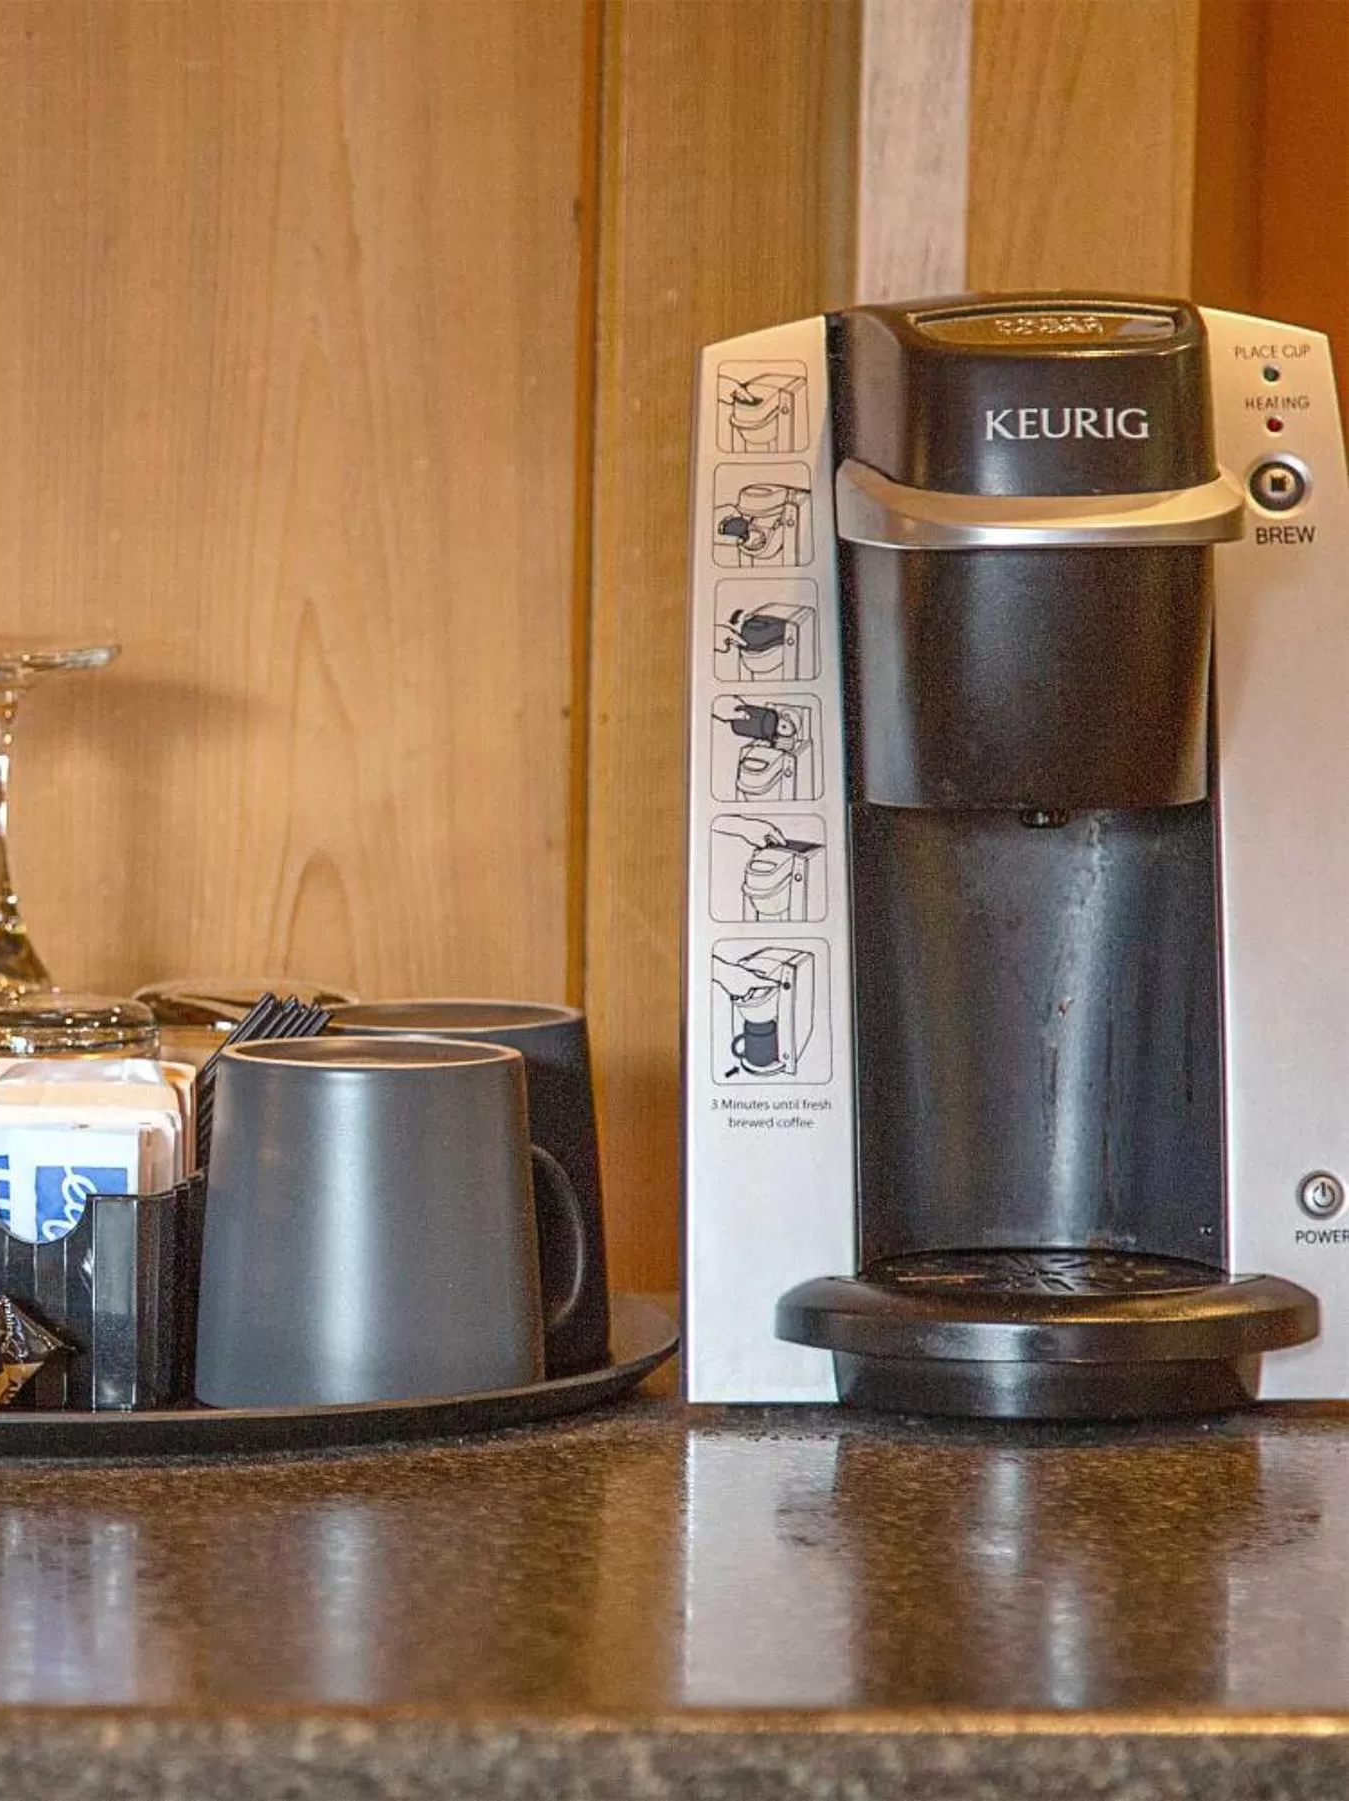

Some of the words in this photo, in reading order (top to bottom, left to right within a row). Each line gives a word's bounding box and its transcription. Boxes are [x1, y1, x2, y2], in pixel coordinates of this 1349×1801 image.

[1233, 345, 1278, 360] PLACE
[1282, 344, 1311, 358] CUP
[1244, 396, 1310, 411] HEATING
[984, 407, 1149, 441] KEURIG
[1256, 526, 1315, 545] BREW
[711, 1099, 718, 1110] 3
[721, 1099, 770, 1110] Minutes
[772, 1099, 799, 1110] until
[802, 1099, 832, 1110] fresh
[729, 1117, 774, 1128] brewed
[776, 1116, 815, 1128] coffee
[1295, 1230, 1349, 1244] POWER
